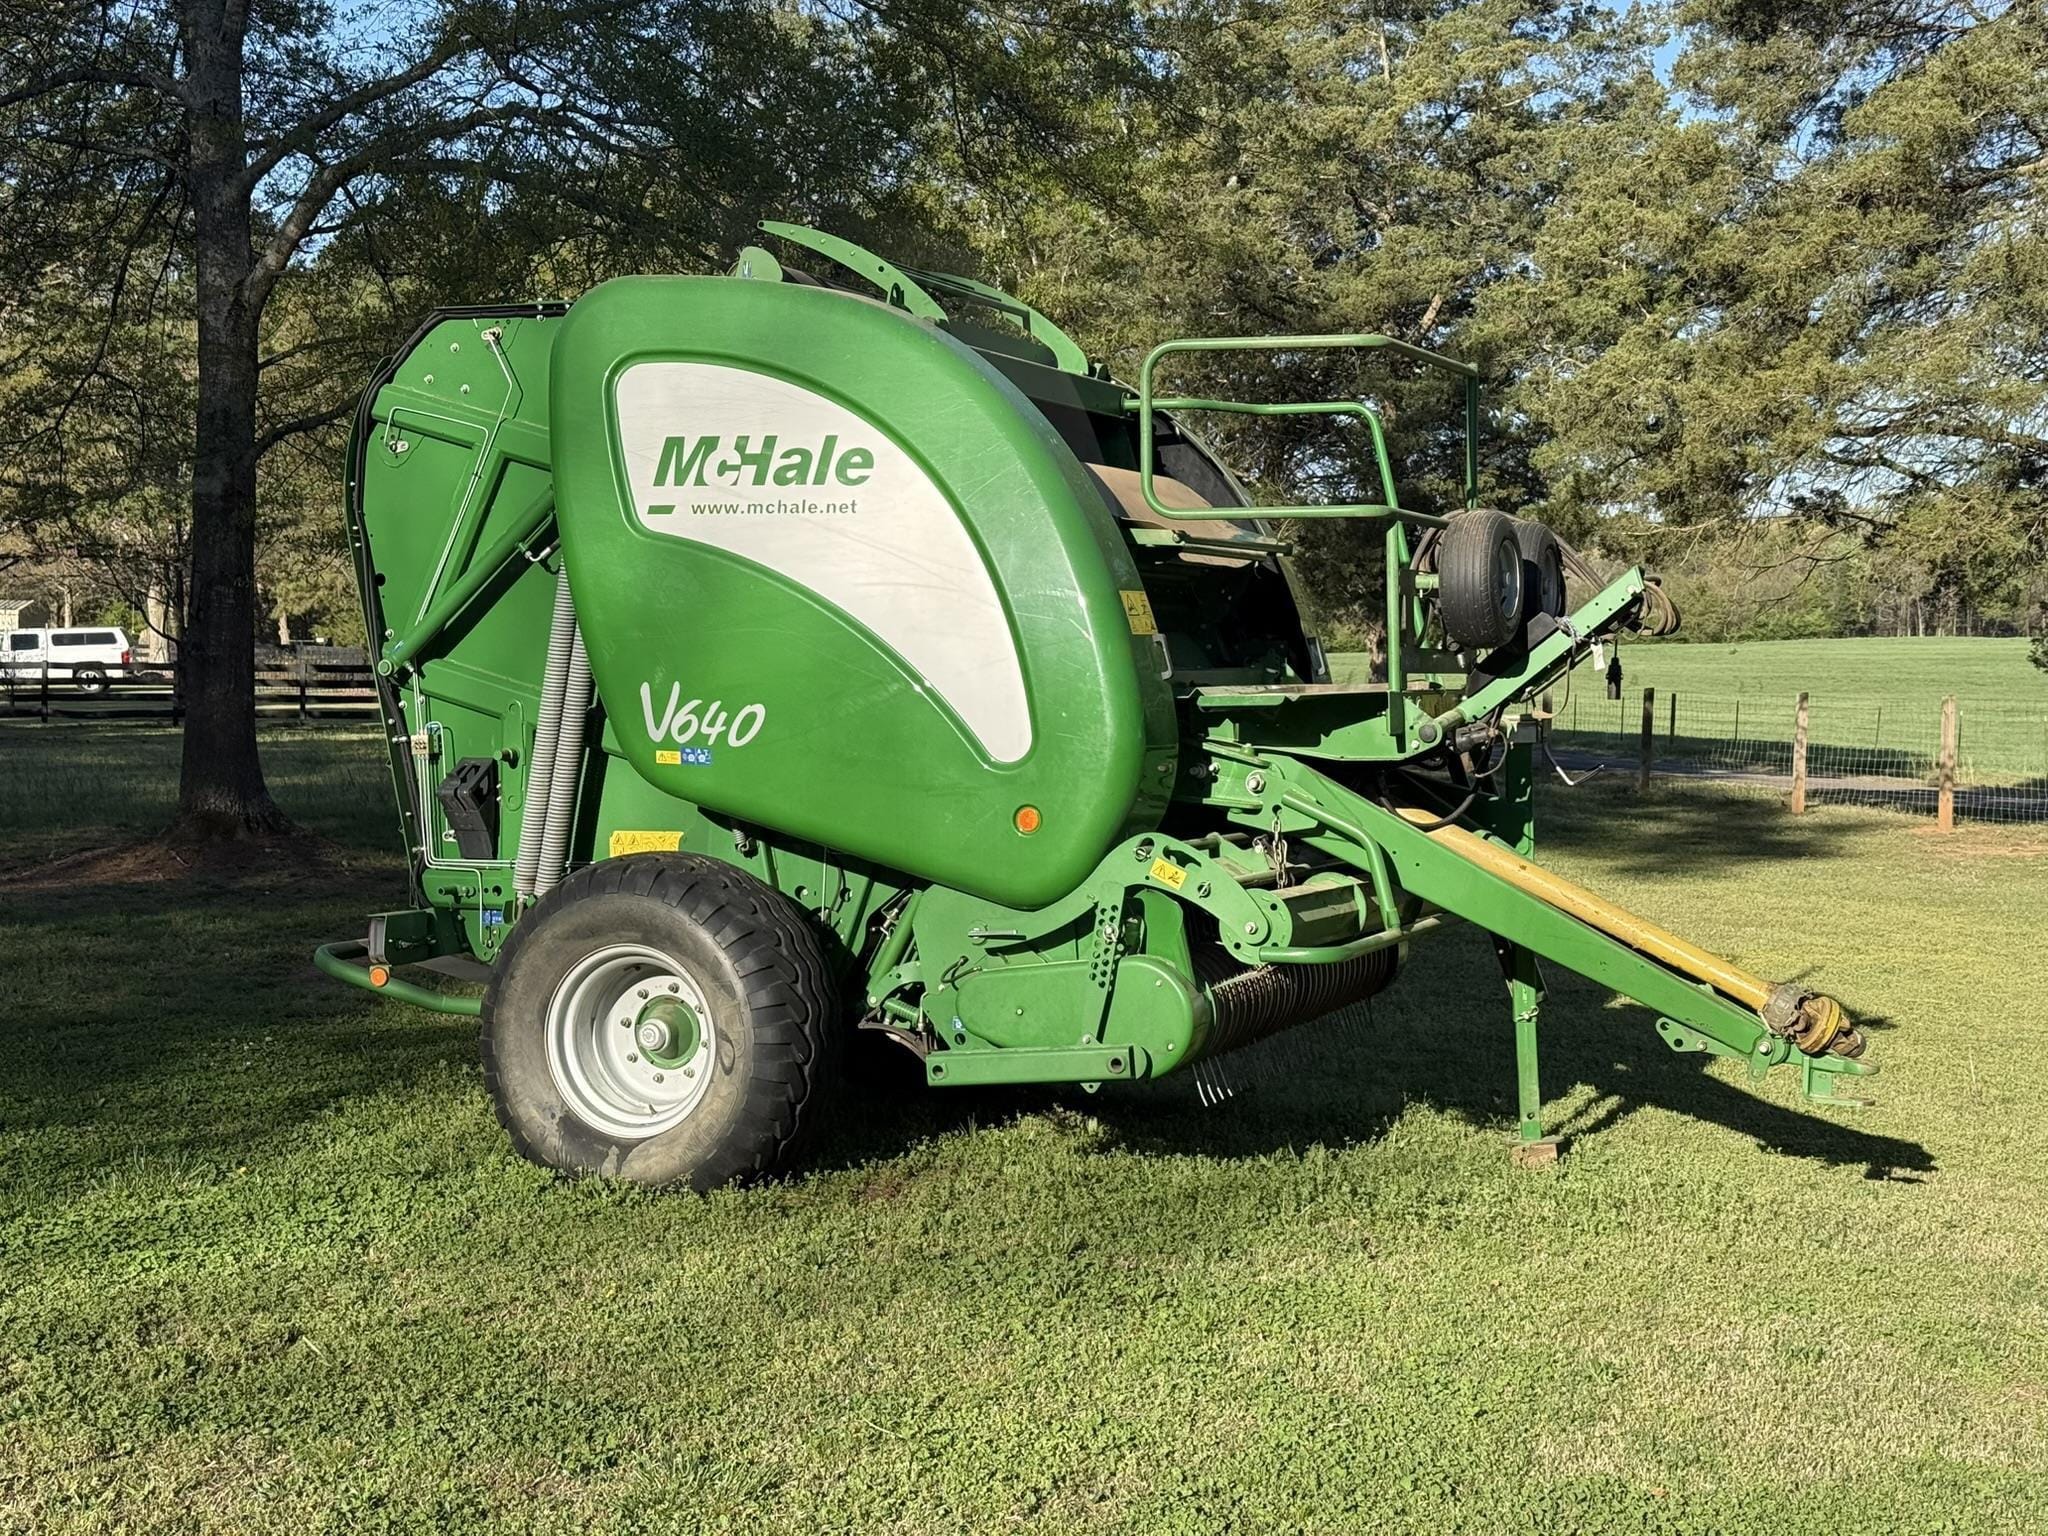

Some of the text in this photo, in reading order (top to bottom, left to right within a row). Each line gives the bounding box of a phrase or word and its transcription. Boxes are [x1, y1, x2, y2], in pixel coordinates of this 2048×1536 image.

[652, 435, 875, 487] McHale
[691, 499, 858, 516] www.mchale.net
[640, 680, 766, 748] V640
